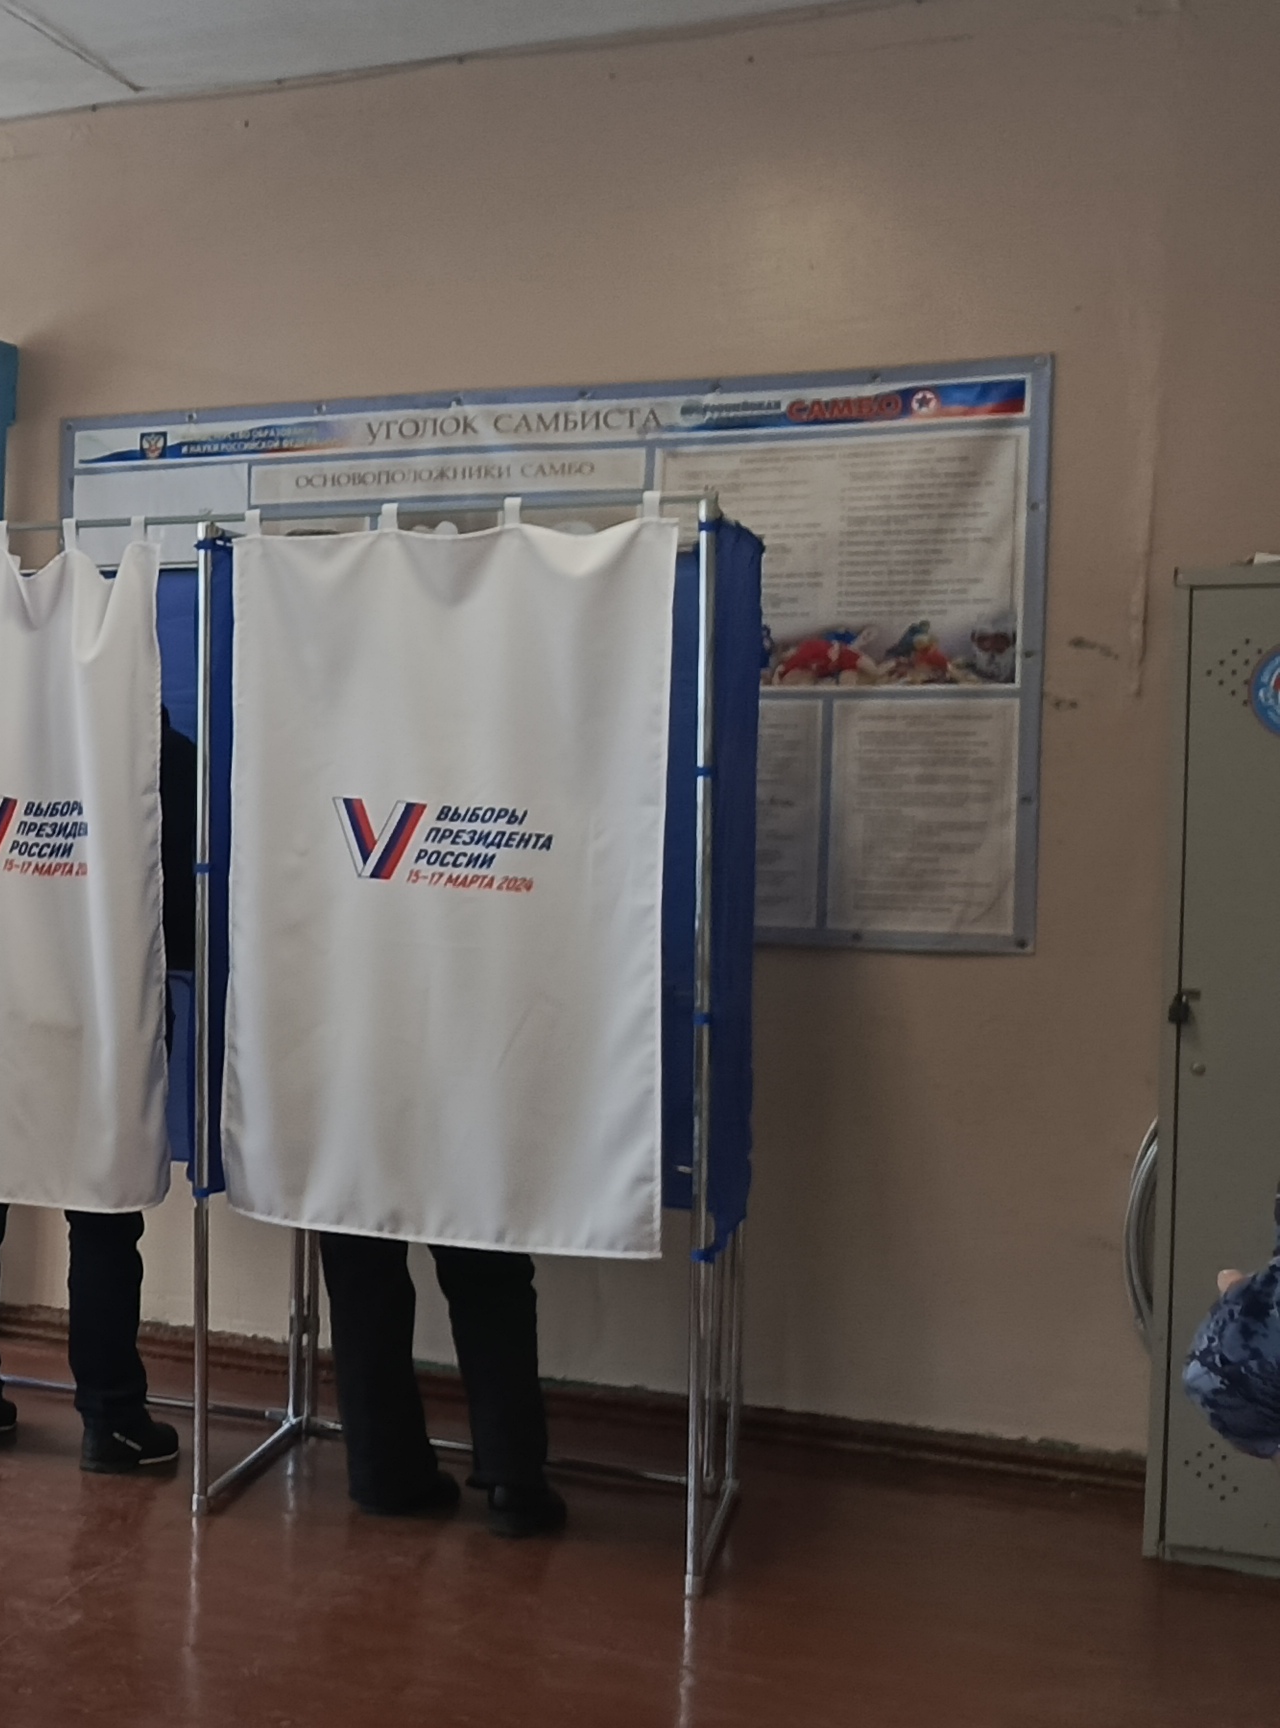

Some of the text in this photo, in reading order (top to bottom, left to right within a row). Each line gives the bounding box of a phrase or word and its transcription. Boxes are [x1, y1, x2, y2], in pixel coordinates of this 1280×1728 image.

[787, 394, 901, 423] САМБО
[366, 407, 663, 446] УГОЛОК САМБИСТА
[295, 461, 595, 489] ОСНОВОПОЛОЖНИКИ САМБО
[435, 805, 528, 826] ВЫБОРЫ
[8, 839, 74, 859] РОССИИ
[424, 827, 554, 852] ПРЕЗИДЕНТА
[2, 859, 33, 875] 15-17
[32, 861, 74, 877] МАРТА
[414, 848, 497, 869] РОССИИ
[405, 868, 534, 893] 15-17 МАРТА 2024
